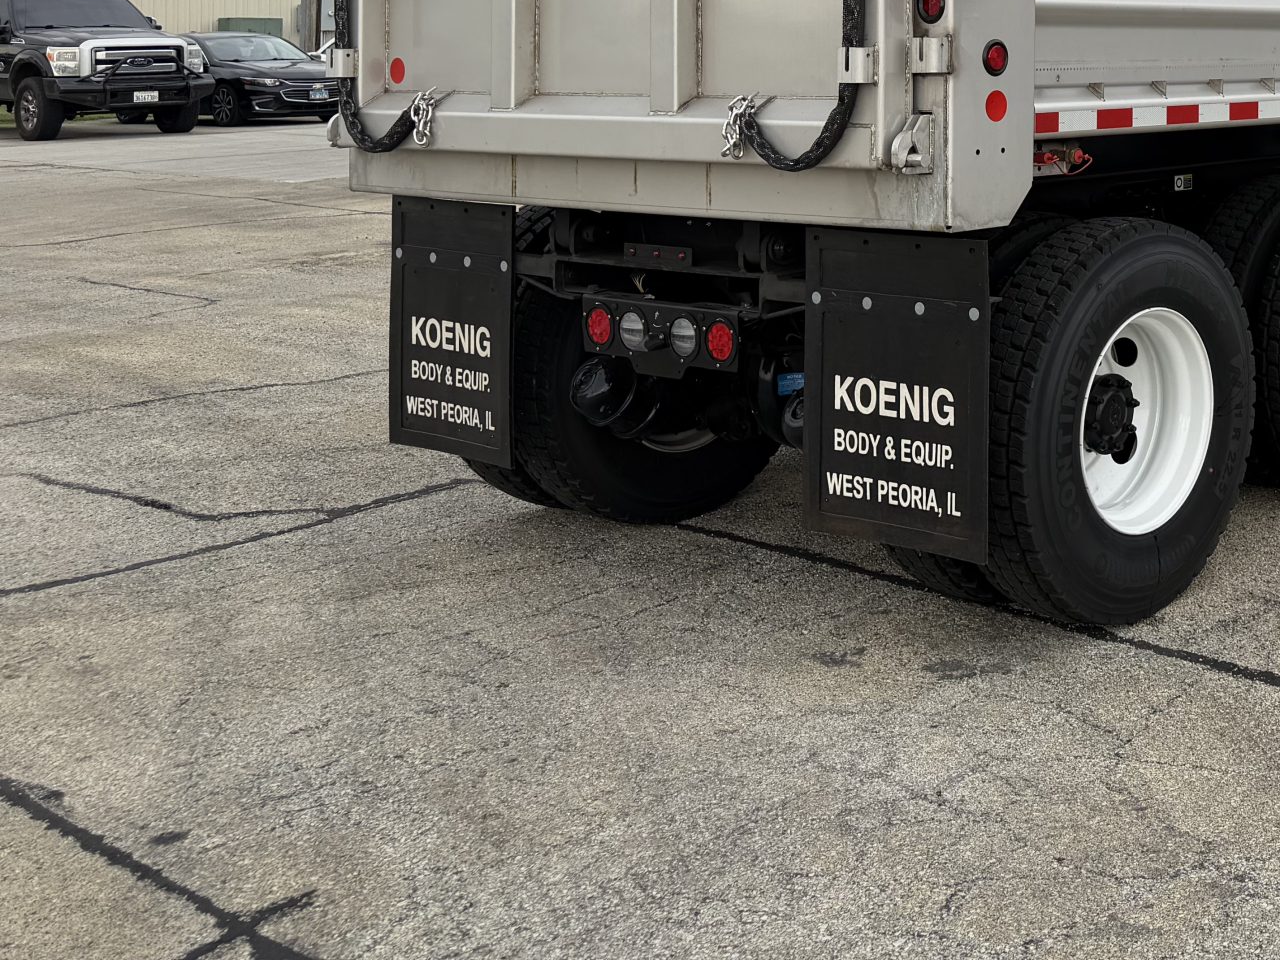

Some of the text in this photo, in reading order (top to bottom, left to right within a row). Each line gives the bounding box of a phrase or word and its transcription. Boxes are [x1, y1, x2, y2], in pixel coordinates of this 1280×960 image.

[411, 316, 491, 358] KOENIG
[411, 360, 490, 392] BODY & EQUIP.
[406, 395, 495, 431] WEST PEORIA, IL
[834, 374, 955, 426] KOENIG
[1056, 281, 1128, 532] CONTINENTAL
[834, 428, 954, 470] BODY & EQUIP.
[826, 472, 961, 517] WEST PEORIA, IL
